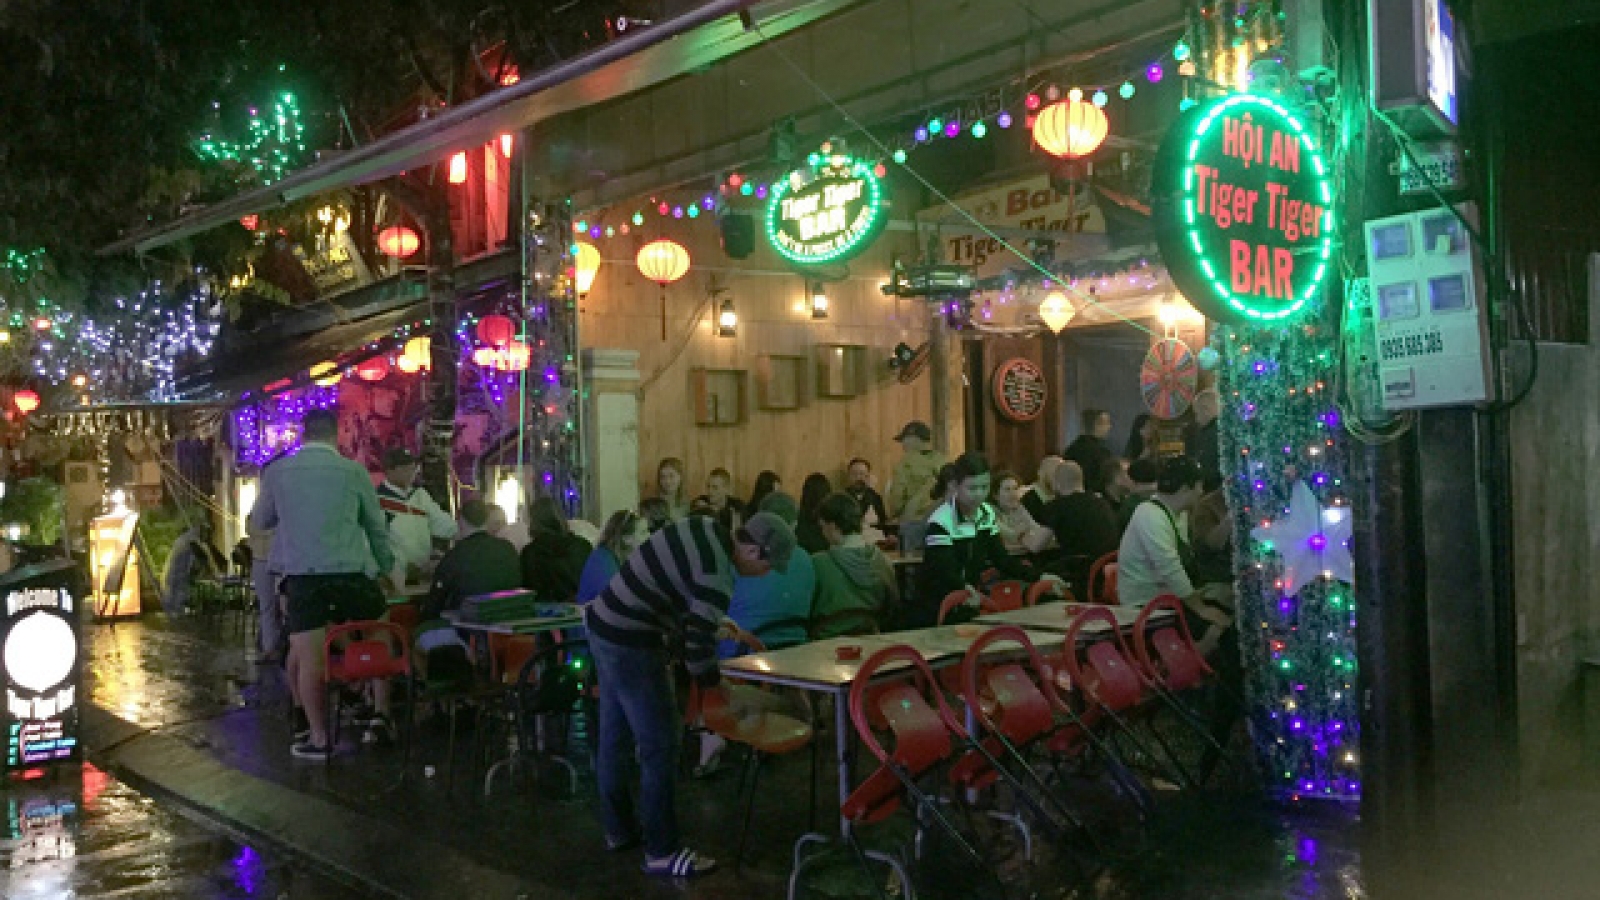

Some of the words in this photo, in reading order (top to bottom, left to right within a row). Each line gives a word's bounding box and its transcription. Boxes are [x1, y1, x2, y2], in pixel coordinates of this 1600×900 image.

[1222, 112, 1263, 168] HỘI
[1269, 130, 1299, 173] AN
[1195, 164, 1258, 228] Tiger
[1265, 182, 1324, 241] Tiger
[1230, 239, 1293, 301] BAR
